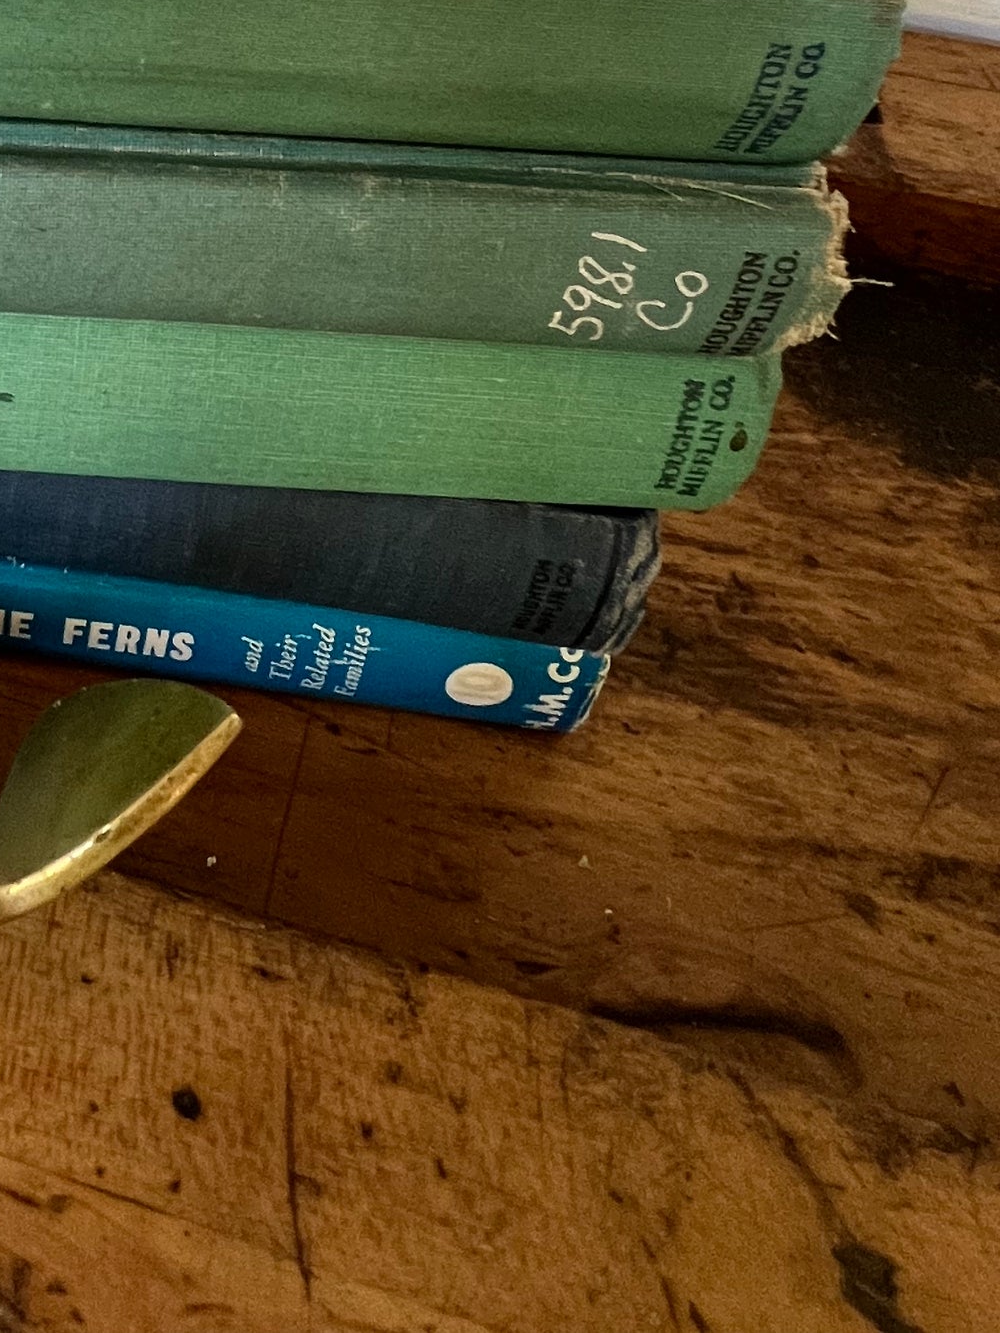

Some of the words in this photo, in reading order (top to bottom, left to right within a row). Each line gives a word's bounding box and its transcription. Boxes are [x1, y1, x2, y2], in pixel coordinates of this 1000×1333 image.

[713, 42, 792, 152] HOUGHTON
[547, 231, 648, 341] 598.1
[696, 251, 768, 354] HOUGHTON
[725, 291, 786, 357] MIFFLIN
[767, 250, 801, 288] CO.
[653, 379, 706, 489] HOUGHTON
[676, 419, 725, 497] MIFFLIN
[709, 375, 736, 411] CO.
[62, 617, 196, 662] FERNS
[240, 635, 264, 673] and
[268, 633, 298, 681] Their
[301, 622, 337, 690] Related
[334, 624, 373, 697] Families
